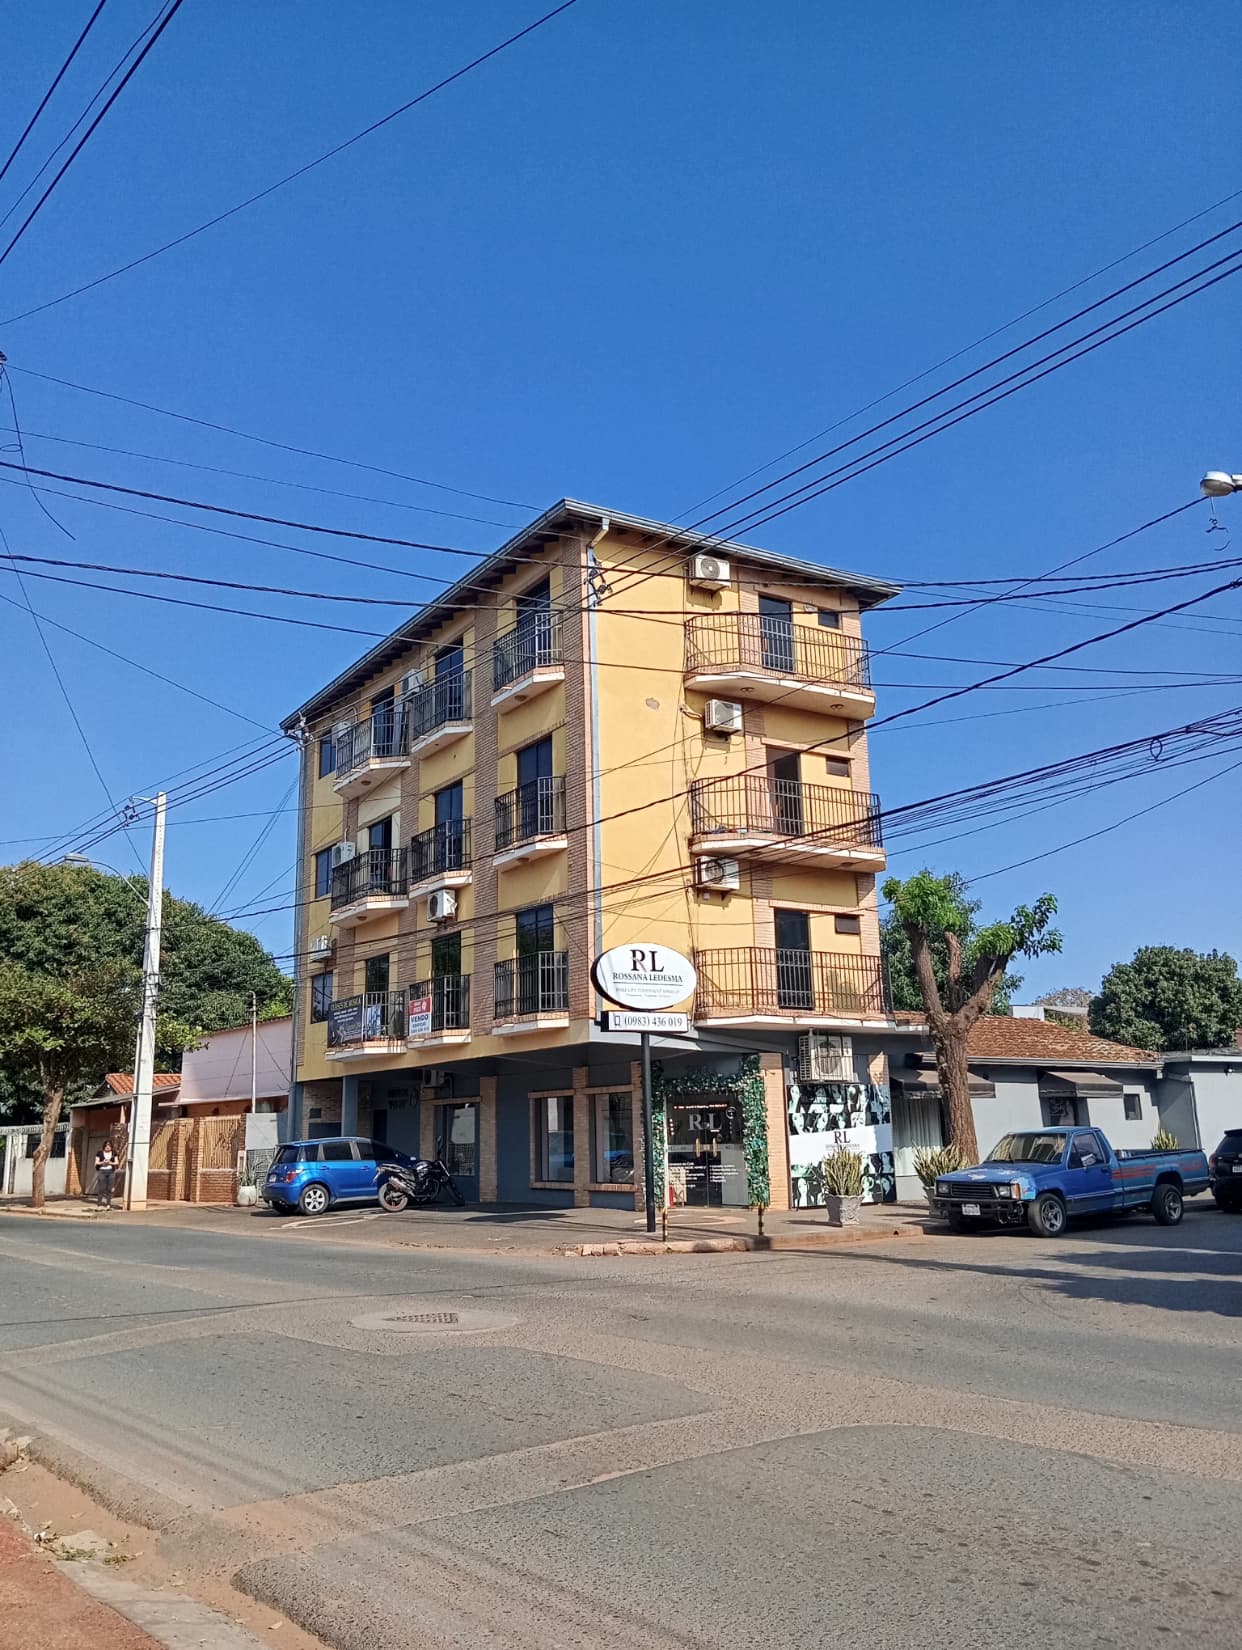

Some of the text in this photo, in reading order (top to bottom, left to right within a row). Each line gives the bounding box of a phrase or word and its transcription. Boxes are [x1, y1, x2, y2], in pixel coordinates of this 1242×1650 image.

[630, 949, 665, 973] RL
[612, 972, 683, 983] ROSSANA LEDESMA
[411, 1014, 429, 1023] VENDO
[624, 1015, 683, 1027] (0983) 436 019
[834, 1131, 851, 1144] RL
